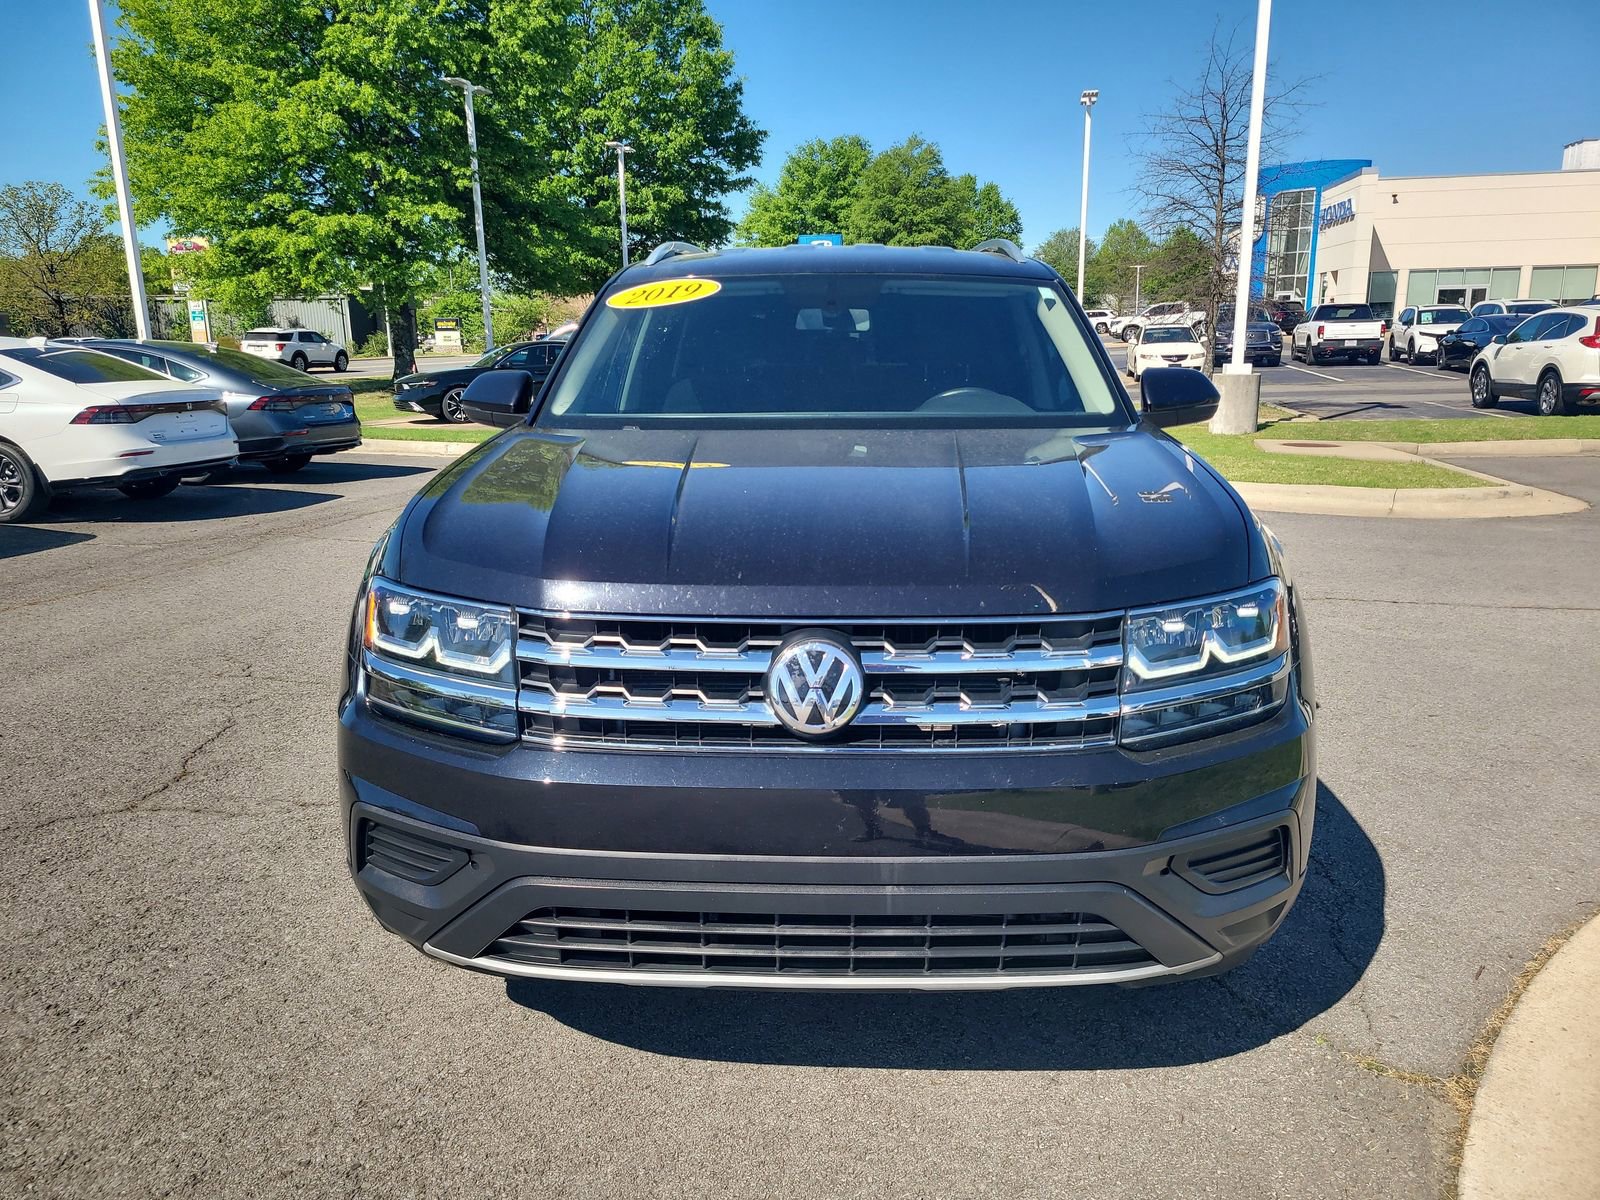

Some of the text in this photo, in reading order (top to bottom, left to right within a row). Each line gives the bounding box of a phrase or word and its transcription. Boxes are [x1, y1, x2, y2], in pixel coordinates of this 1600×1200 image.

[1320, 198, 1354, 226] HONDA
[625, 283, 703, 304] 2019
[771, 641, 861, 731] VW
